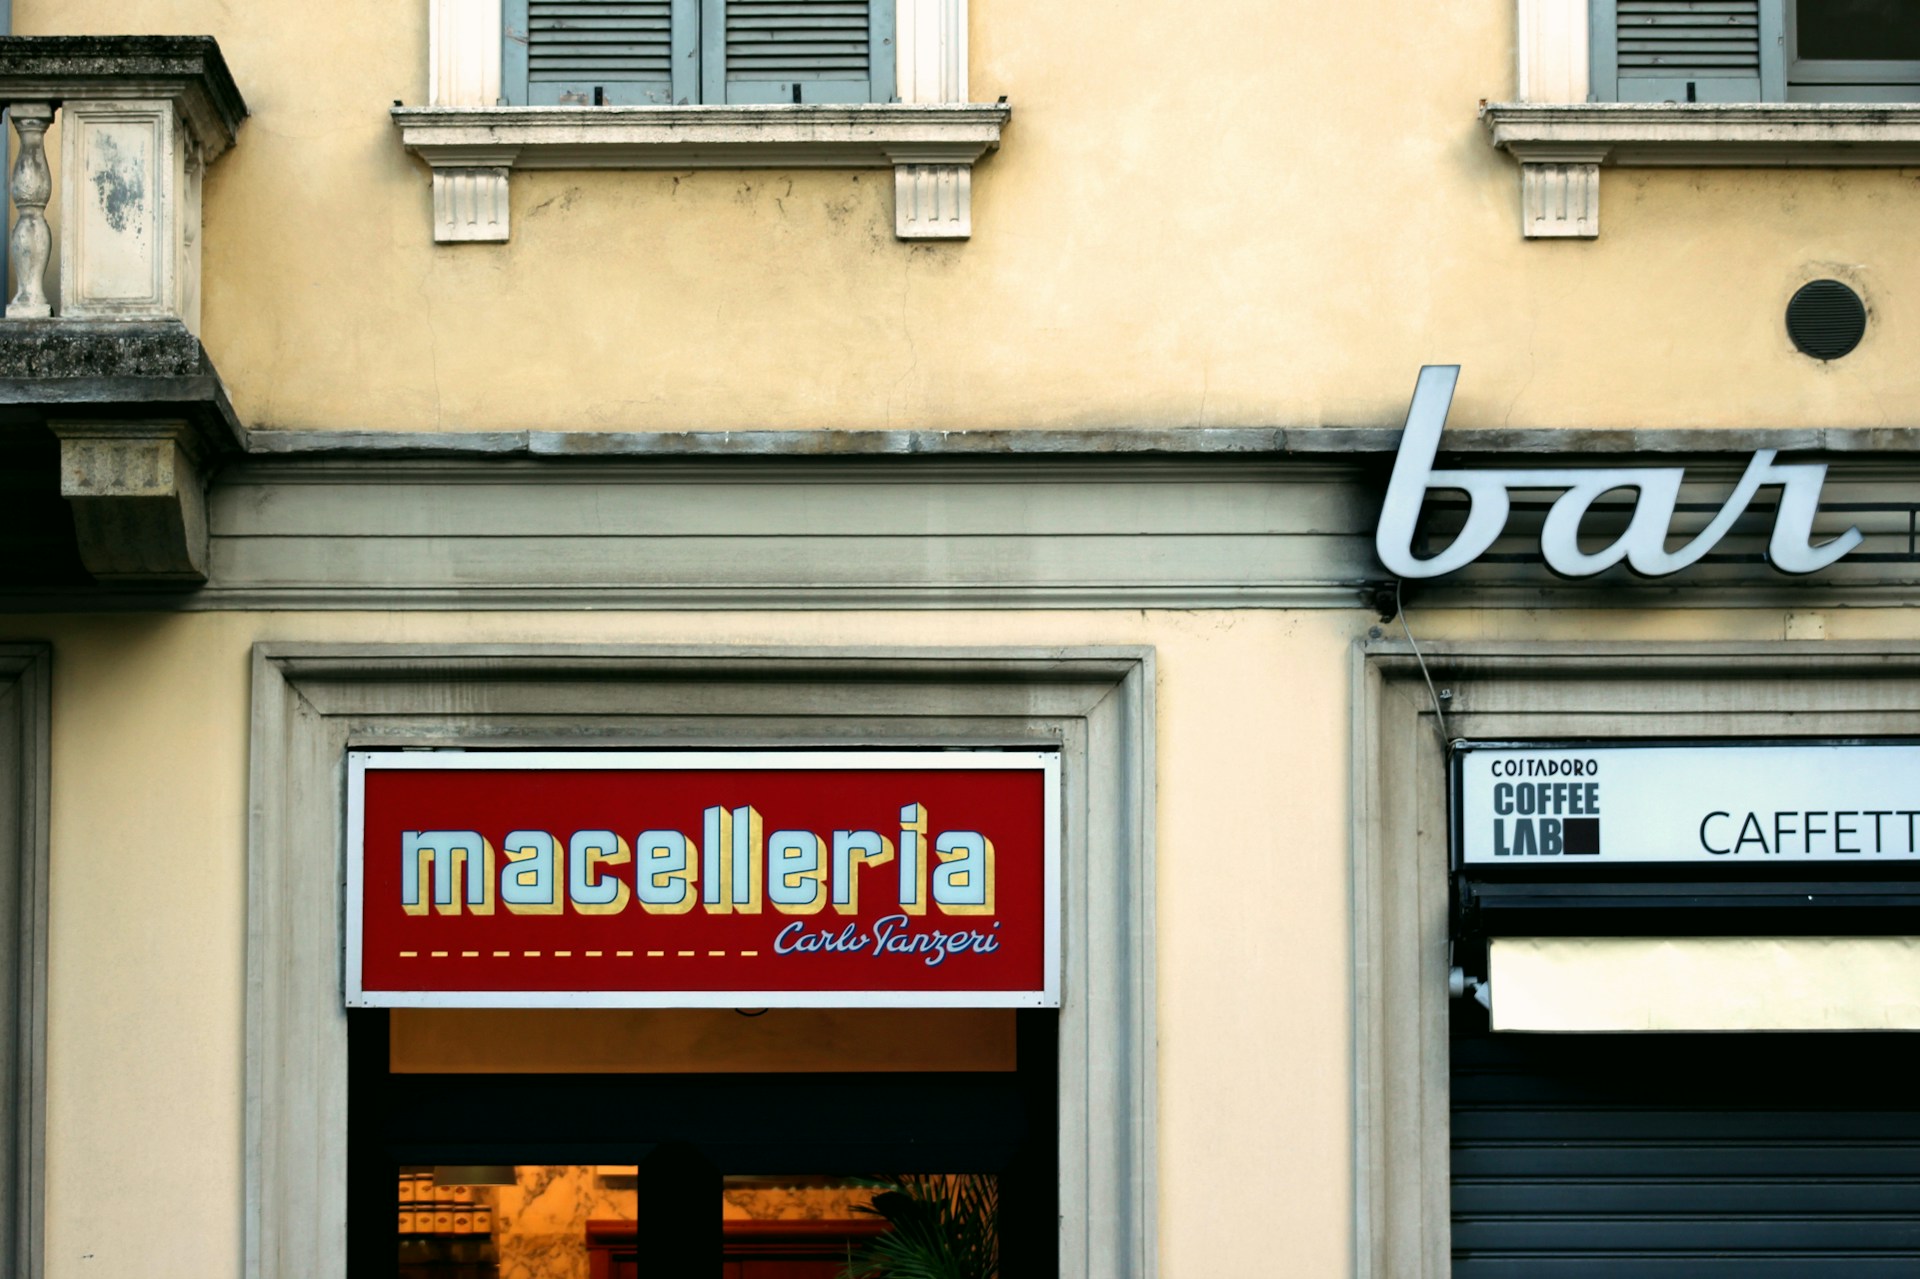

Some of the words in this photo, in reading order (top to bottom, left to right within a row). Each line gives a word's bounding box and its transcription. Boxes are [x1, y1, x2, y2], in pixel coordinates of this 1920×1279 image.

[1376, 365, 1864, 578] bar
[1491, 758, 1598, 777] COSTADORO
[1493, 782, 1600, 815] COFFEE
[1493, 818, 1562, 856] LAB
[401, 802, 996, 916] macelleria
[773, 920, 871, 957] Carlo
